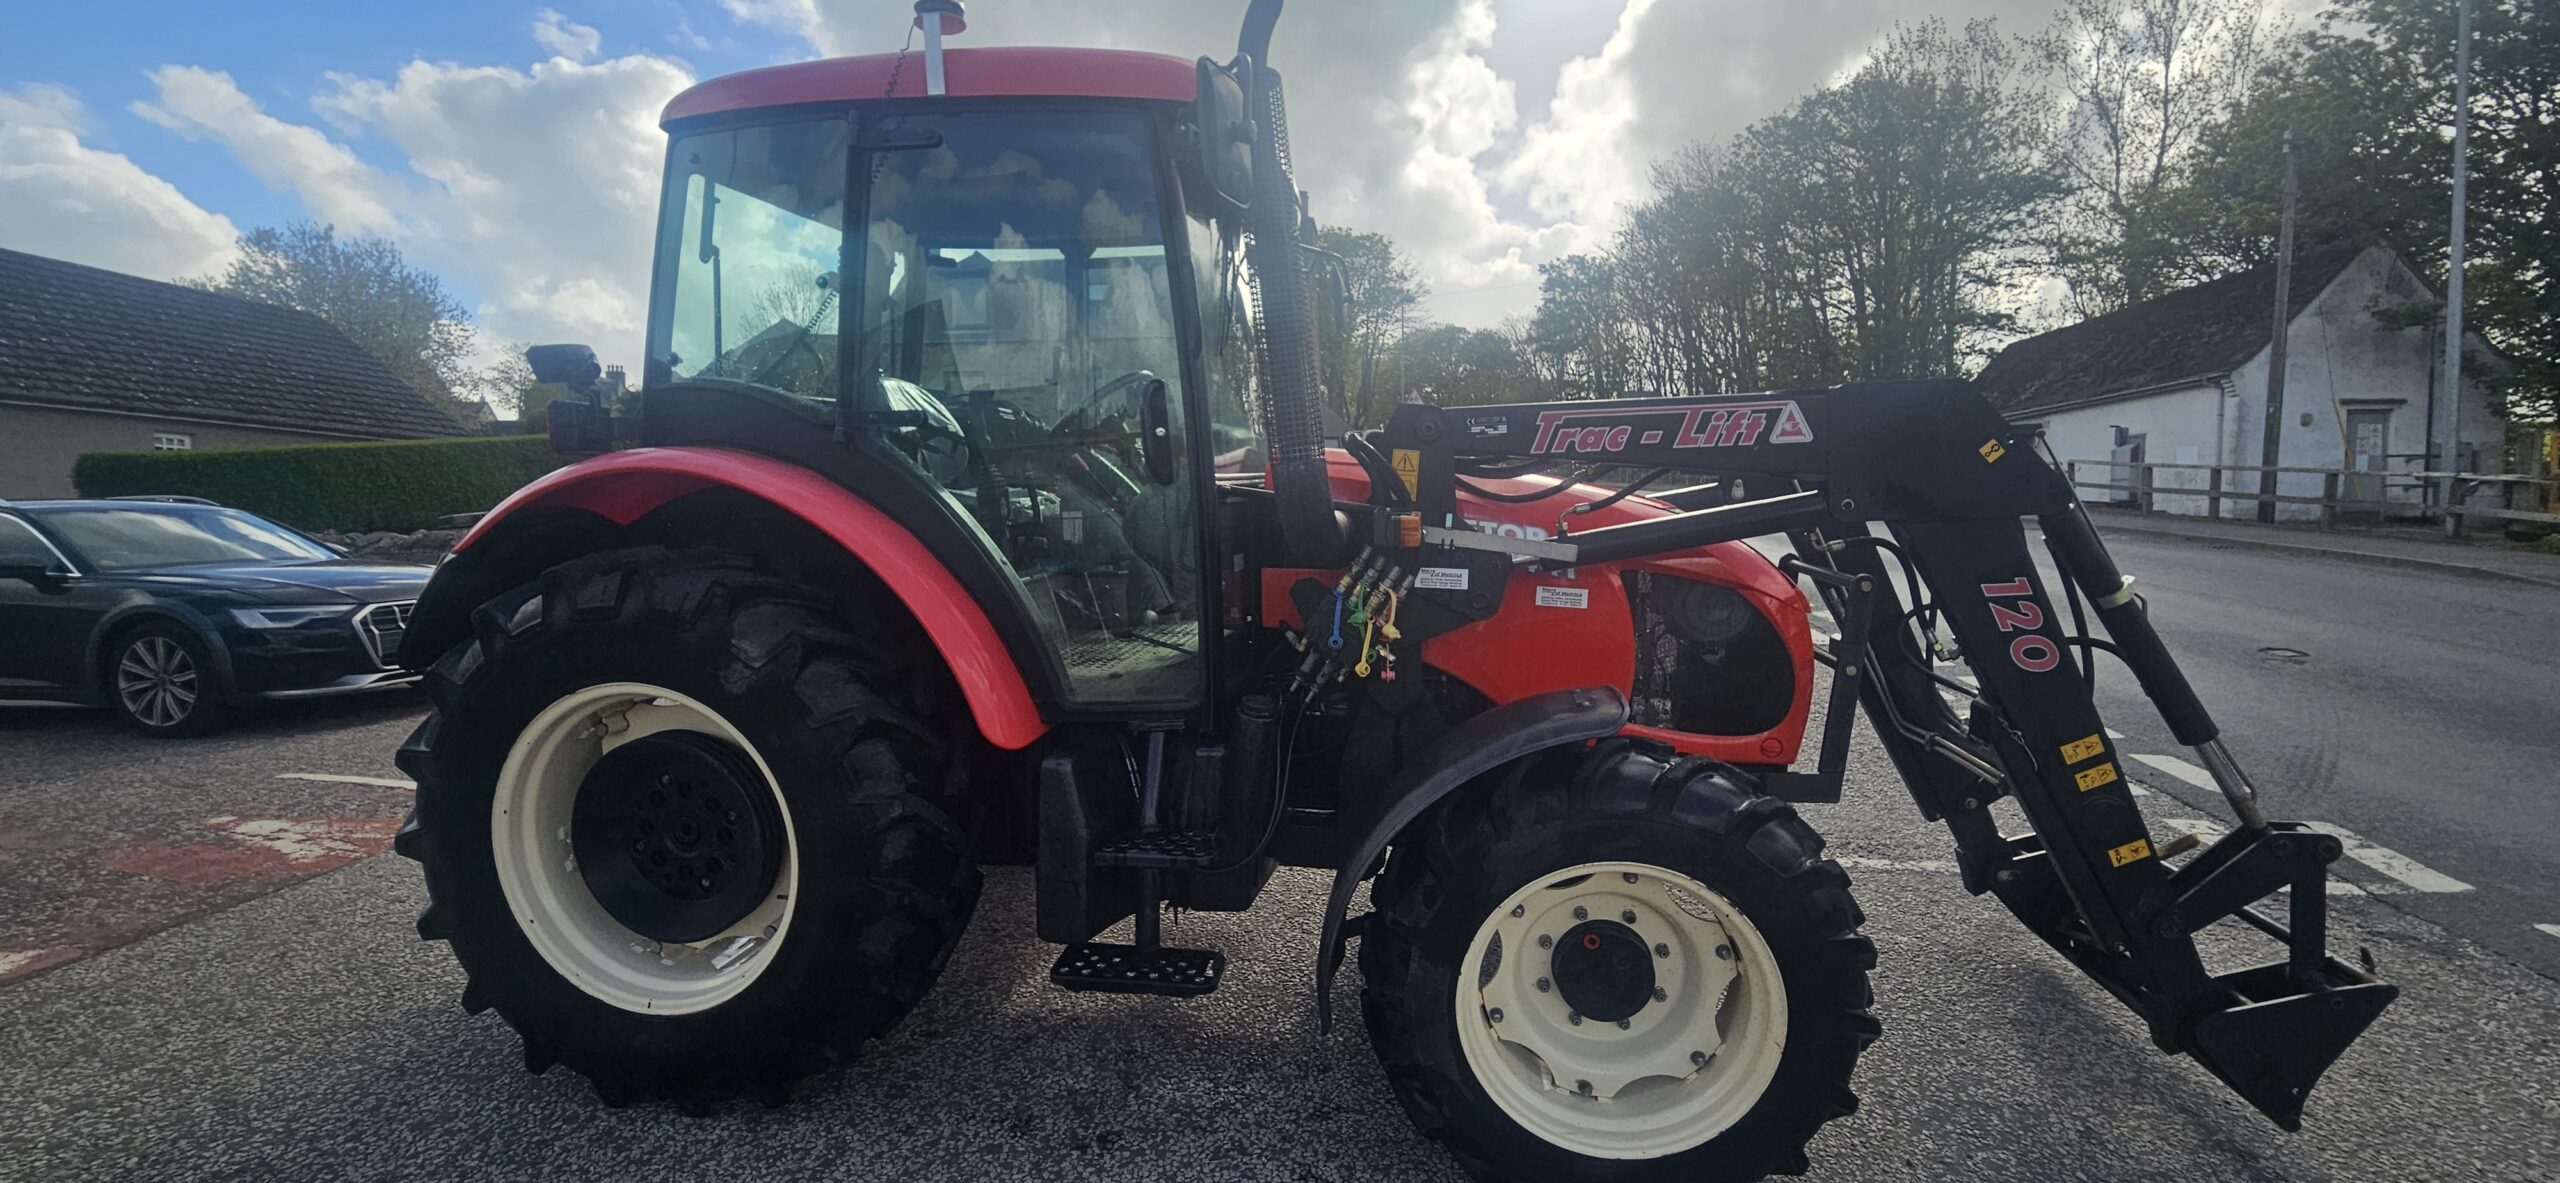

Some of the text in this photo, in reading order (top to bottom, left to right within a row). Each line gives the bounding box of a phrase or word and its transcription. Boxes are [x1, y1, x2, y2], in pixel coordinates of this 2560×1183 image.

[1530, 408, 1632, 454] Trac
[1672, 406, 1767, 449] Lift
[1980, 577, 2060, 672] 120
